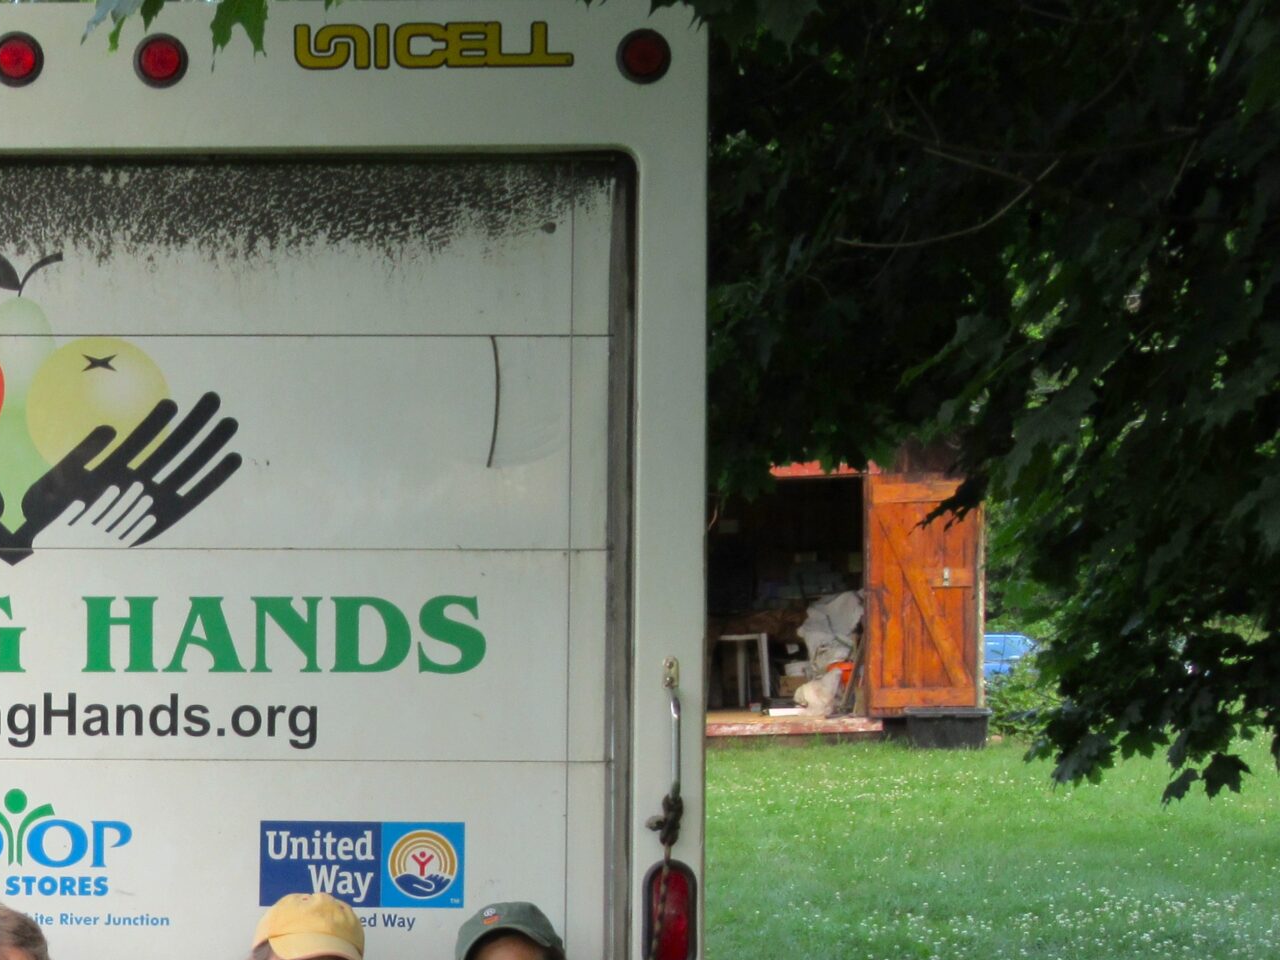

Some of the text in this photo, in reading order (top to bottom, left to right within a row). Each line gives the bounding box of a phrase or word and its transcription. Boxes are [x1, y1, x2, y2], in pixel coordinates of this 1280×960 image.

[294, 21, 574, 69] UNICELL
[81, 595, 488, 675] HANDS
[266, 830, 375, 902] United Way
[5, 877, 109, 896] STORES
[59, 913, 99, 926] River
[104, 914, 170, 926] Junction
[382, 914, 416, 931] Way
